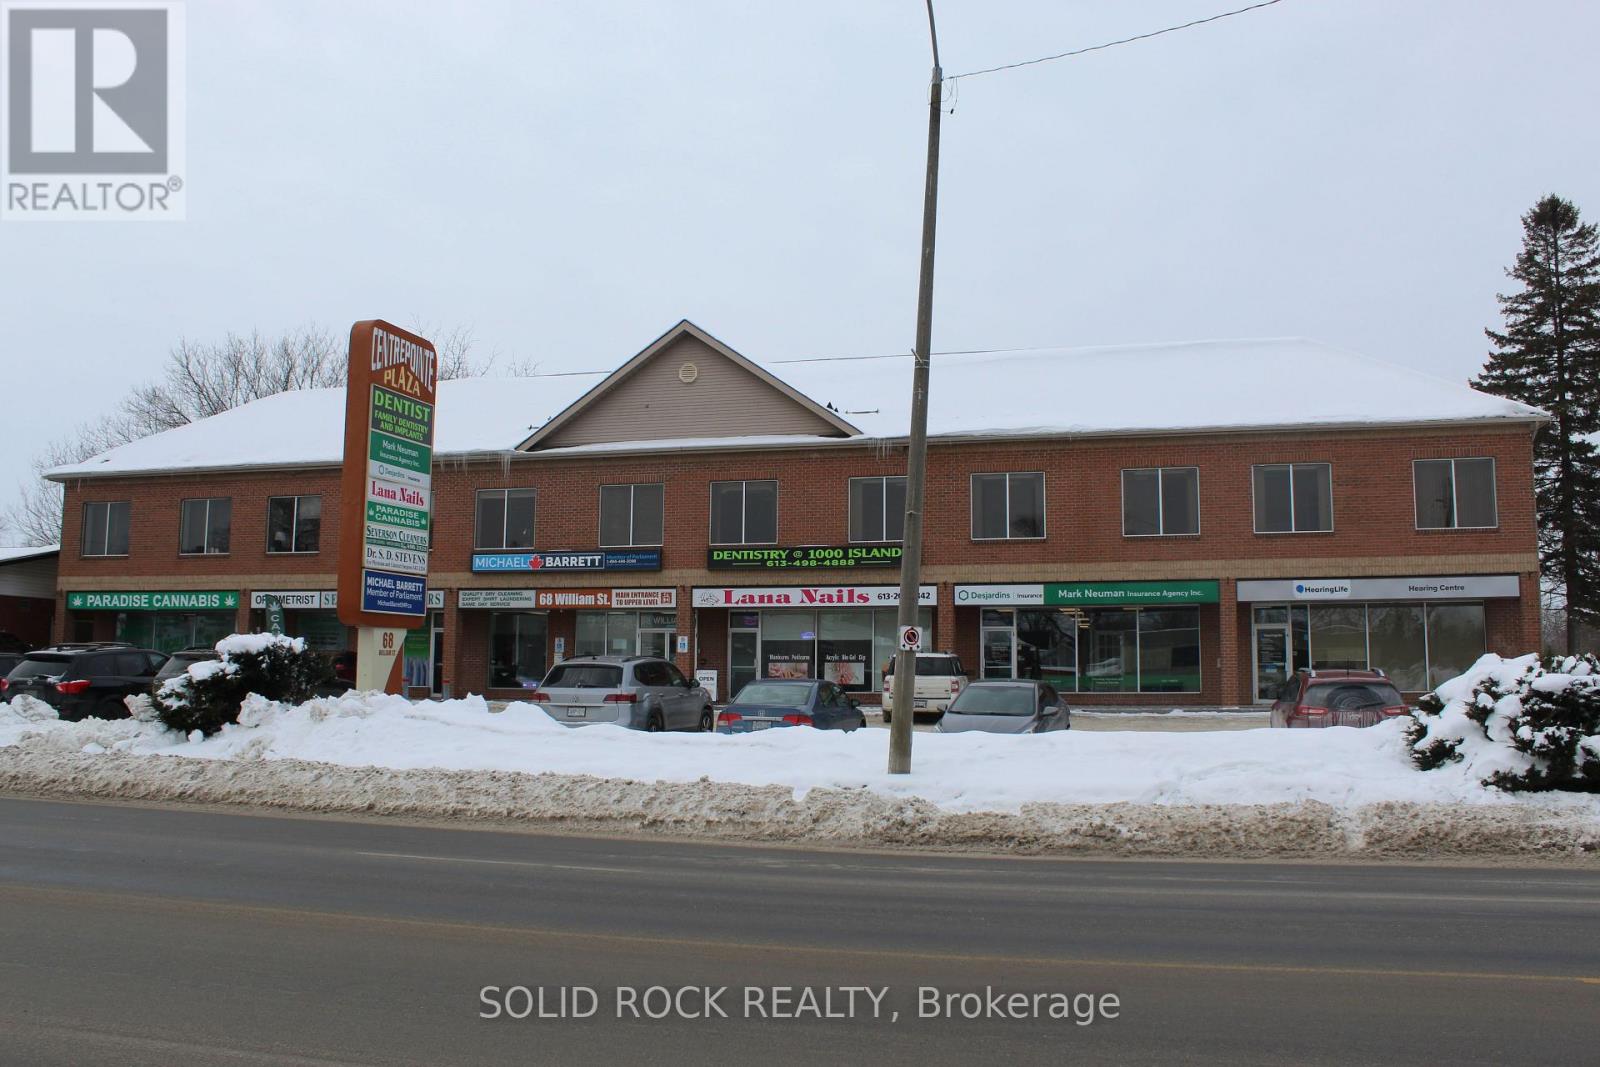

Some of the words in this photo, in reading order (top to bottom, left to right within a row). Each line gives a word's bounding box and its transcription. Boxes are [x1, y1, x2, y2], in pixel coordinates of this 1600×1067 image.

[371, 327, 434, 394] CENTREPOINTE
[384, 366, 420, 396] PLAZA
[374, 390, 430, 422] DENTIST
[374, 410, 398, 424] FAMILY
[399, 418, 428, 434] DENTISTRY
[380, 421, 394, 431] AND
[394, 425, 424, 440] IMPLANTS
[382, 440, 396, 450] Mark
[396, 444, 419, 458] Neuman
[371, 480, 396, 500] Lana
[399, 488, 424, 506] Nails
[376, 505, 420, 519] PARADISE
[375, 514, 420, 527] CANNABIS
[366, 525, 398, 540] SEVERSON
[398, 530, 428, 545] CLEANERS
[367, 548, 377, 558] Dr.
[386, 550, 394, 560] D.
[394, 552, 426, 565] STEVENS
[713, 550, 789, 560] DENTISTRY
[792, 550, 803, 558] @
[808, 550, 844, 559] 1000
[850, 548, 902, 558] ISLAND
[475, 557, 528, 568] MICHAEL
[545, 556, 602, 567] BARRETT
[366, 576, 395, 588] MICHAEL
[396, 580, 424, 592] BARRETT
[1304, 585, 1348, 594] HearingLife
[1408, 584, 1438, 592] Hearing
[86, 594, 150, 607] PARADISE
[152, 594, 220, 607] CANNABIS
[255, 595, 316, 605] OPMETRIST
[366, 588, 389, 598] Member
[396, 590, 422, 600] Parliament
[540, 593, 553, 605] 68
[555, 592, 594, 605] William
[597, 592, 610, 605] St.
[724, 589, 791, 605] Lana
[800, 588, 870, 604] Nails
[970, 591, 1010, 600] Desjardins
[1058, 590, 1082, 598] Mark
[1084, 589, 1125, 598] Neuman
[1162, 590, 1188, 598] Agency
[653, 616, 677, 626] WILLIA
[382, 632, 394, 649] 68
